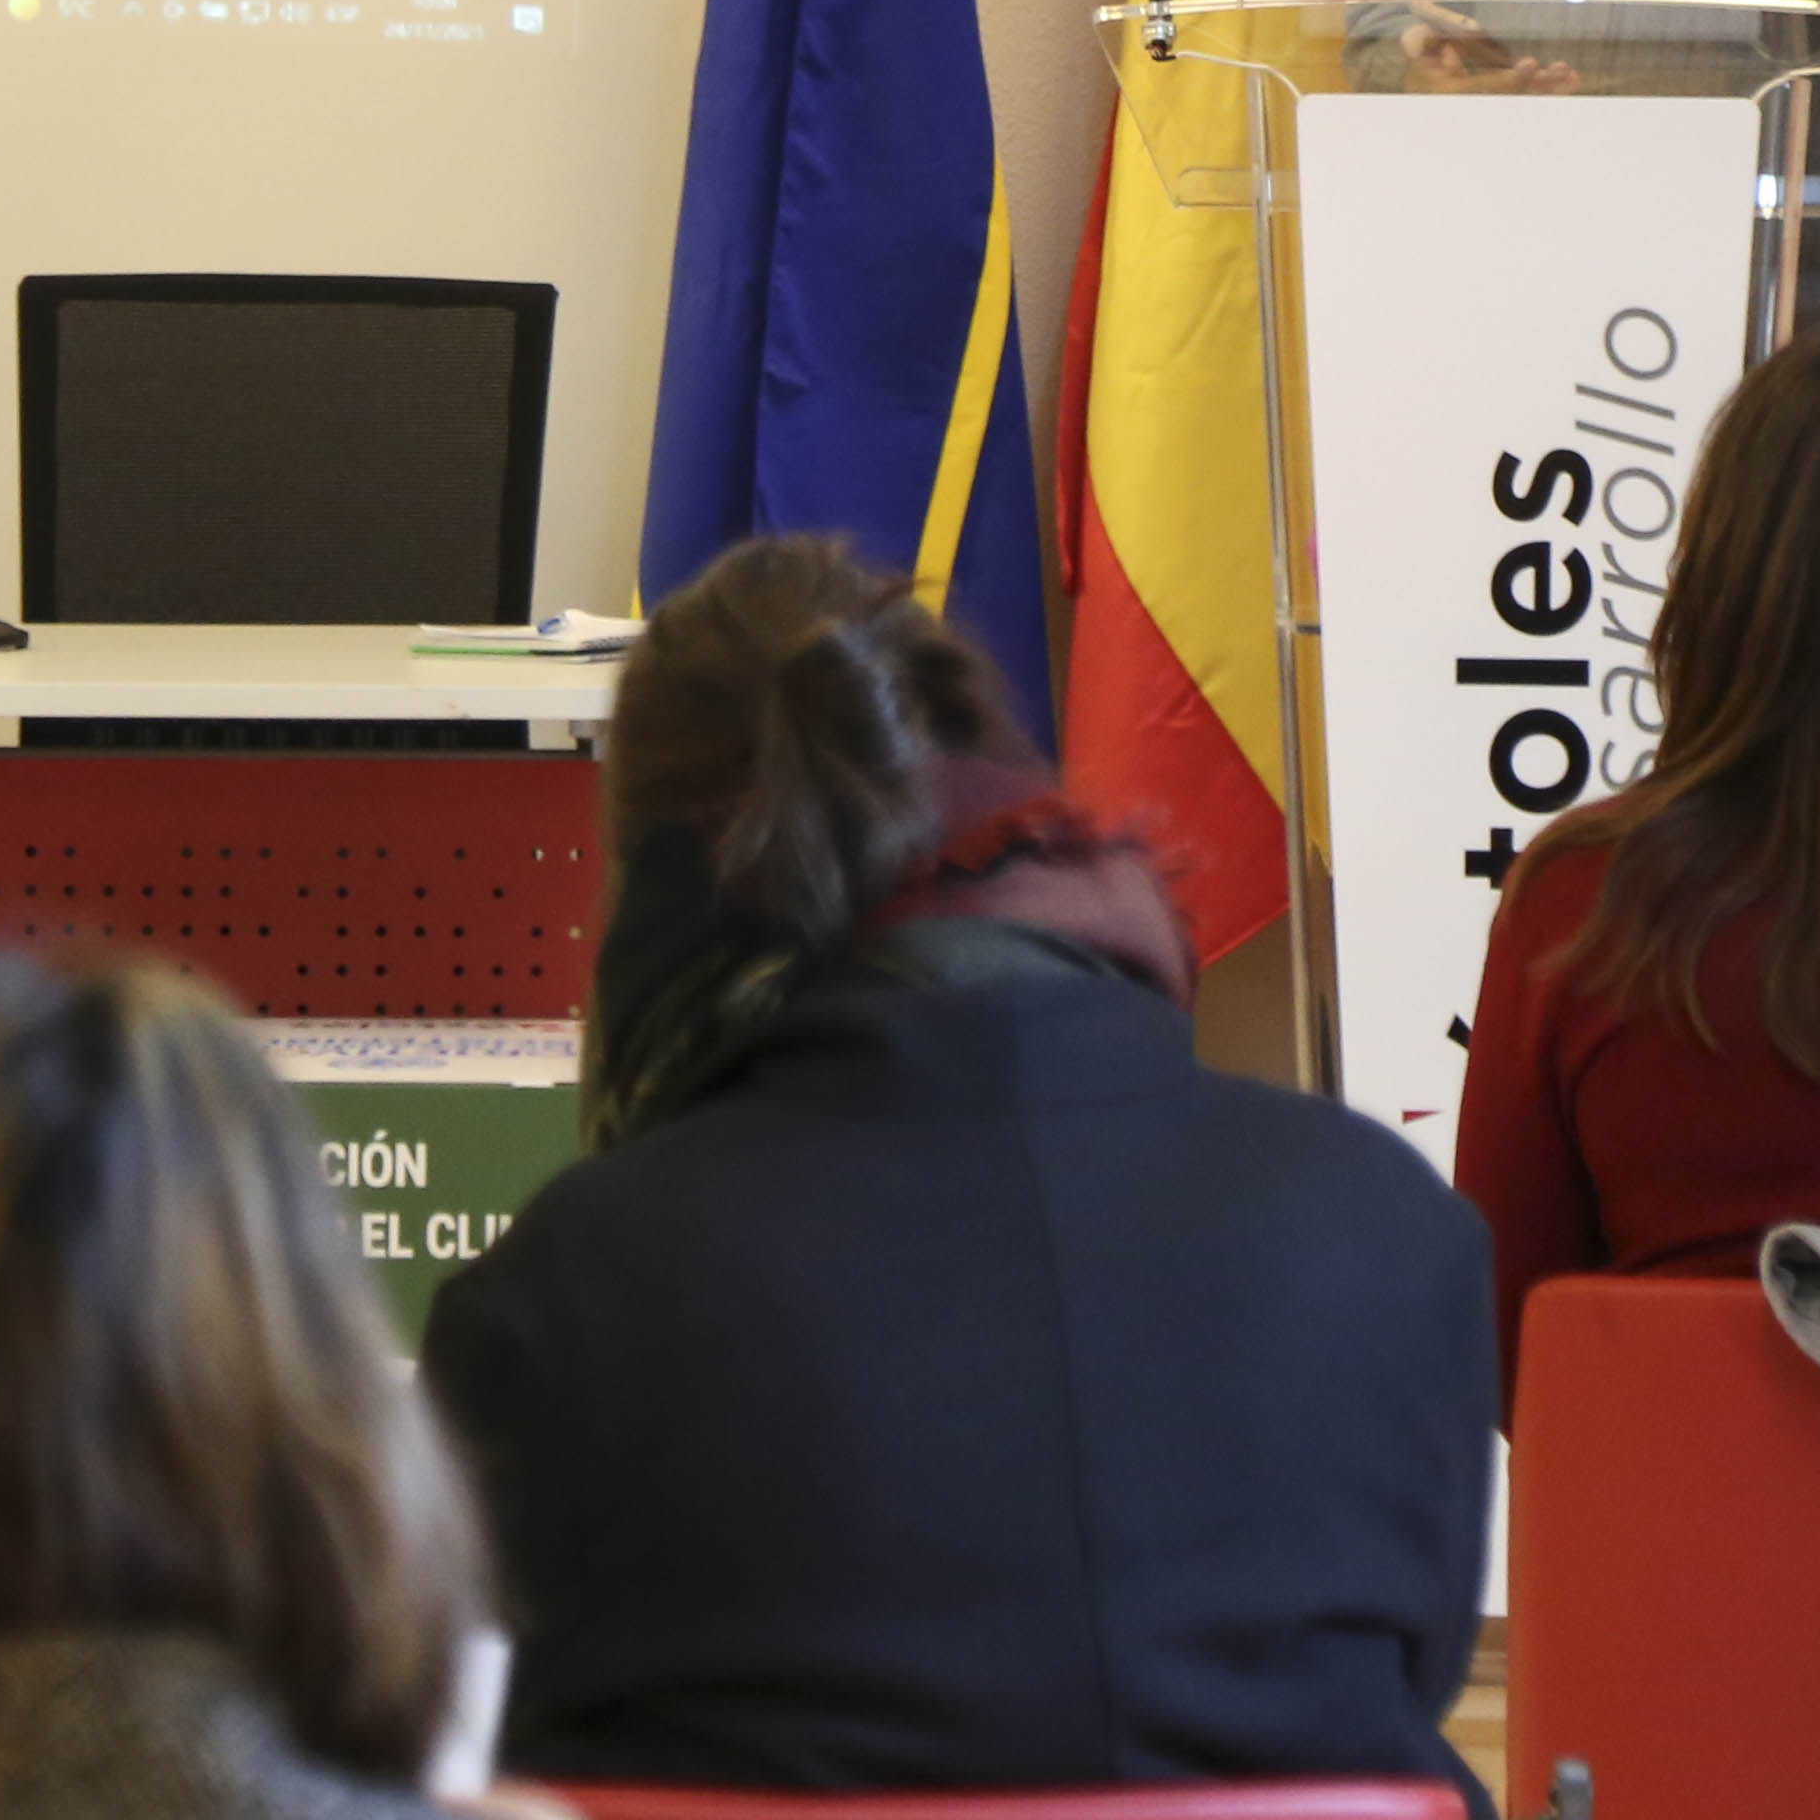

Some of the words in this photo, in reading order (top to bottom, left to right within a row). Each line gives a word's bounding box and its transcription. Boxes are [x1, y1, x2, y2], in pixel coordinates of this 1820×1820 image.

[1574, 307, 1679, 792] sarrollo
[318, 1129, 429, 1189] CIÓN
[360, 1213, 414, 1259] EL
